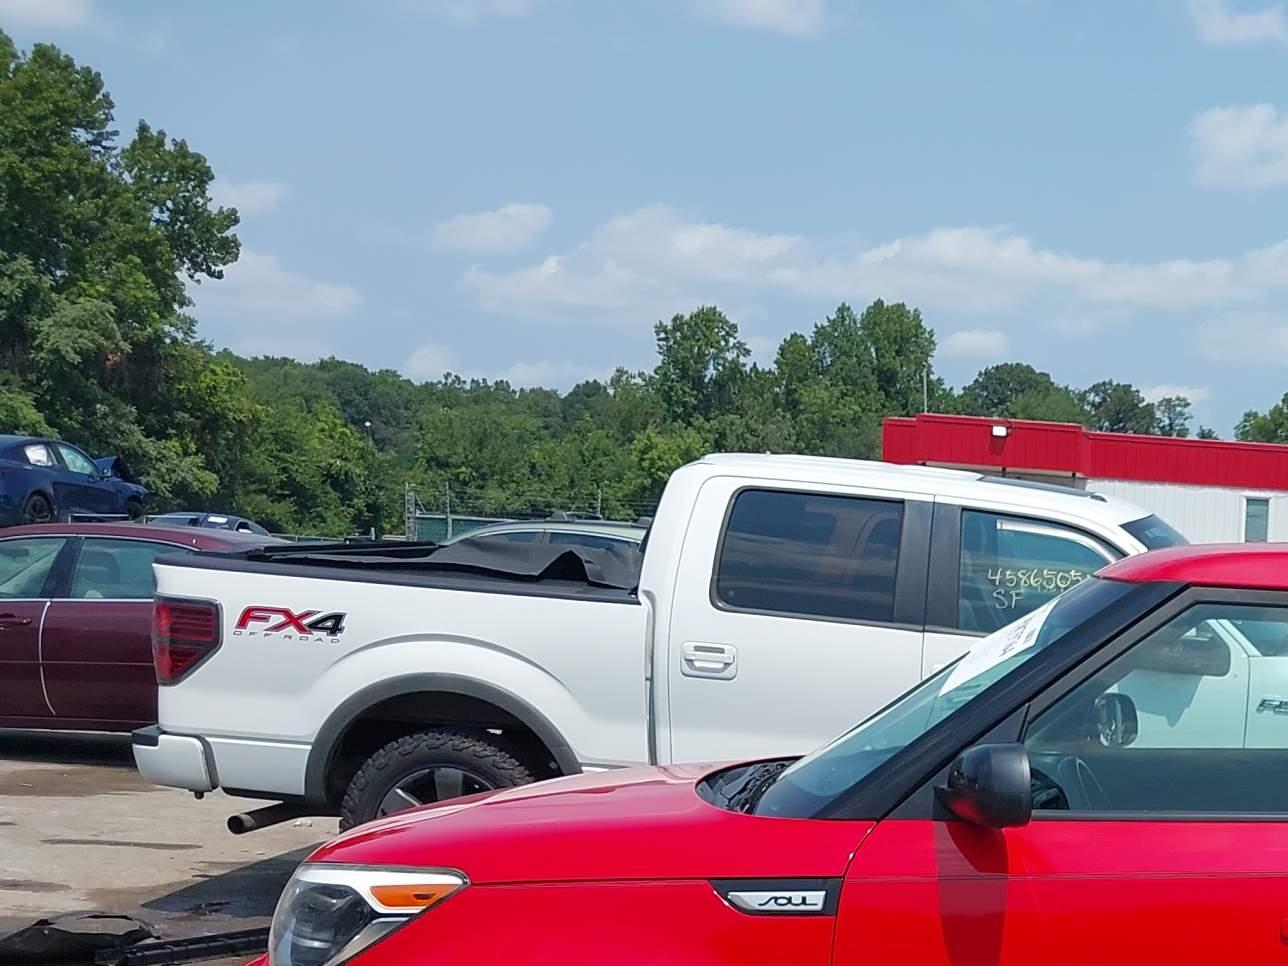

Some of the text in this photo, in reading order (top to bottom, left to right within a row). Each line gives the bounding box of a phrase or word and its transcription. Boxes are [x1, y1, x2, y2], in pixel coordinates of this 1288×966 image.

[993, 589, 1024, 608] SF
[235, 606, 347, 636] FX4
[284, 634, 340, 643] ROAD
[758, 895, 818, 906] SOUL
